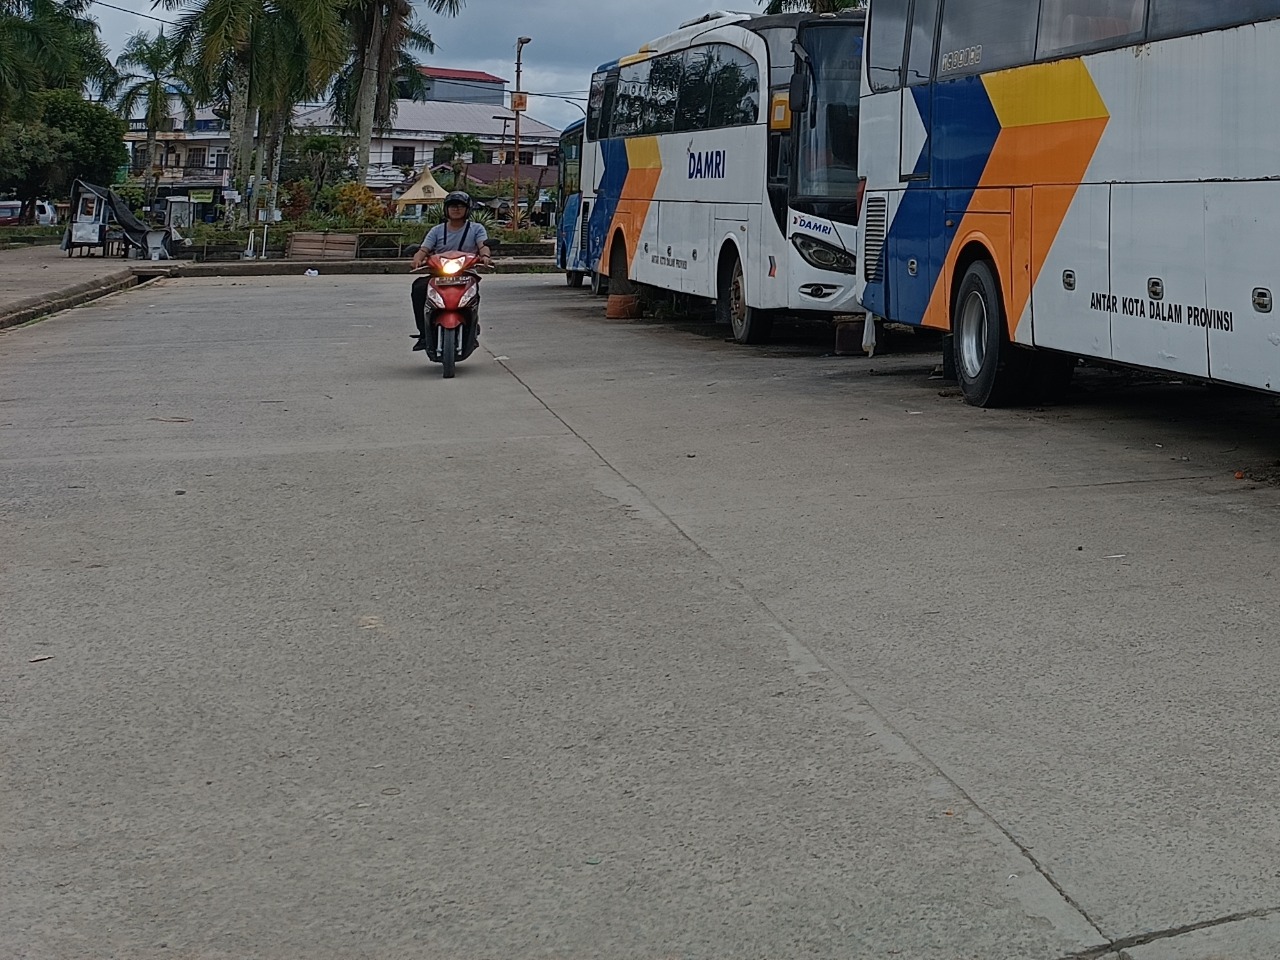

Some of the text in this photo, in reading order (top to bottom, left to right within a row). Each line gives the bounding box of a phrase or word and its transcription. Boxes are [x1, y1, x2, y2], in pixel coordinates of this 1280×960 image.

[688, 149, 726, 179] DAMRI
[799, 218, 832, 235] DAMRI
[1090, 292, 1234, 332] ANTAR KOTA DALAM PROVINSI
